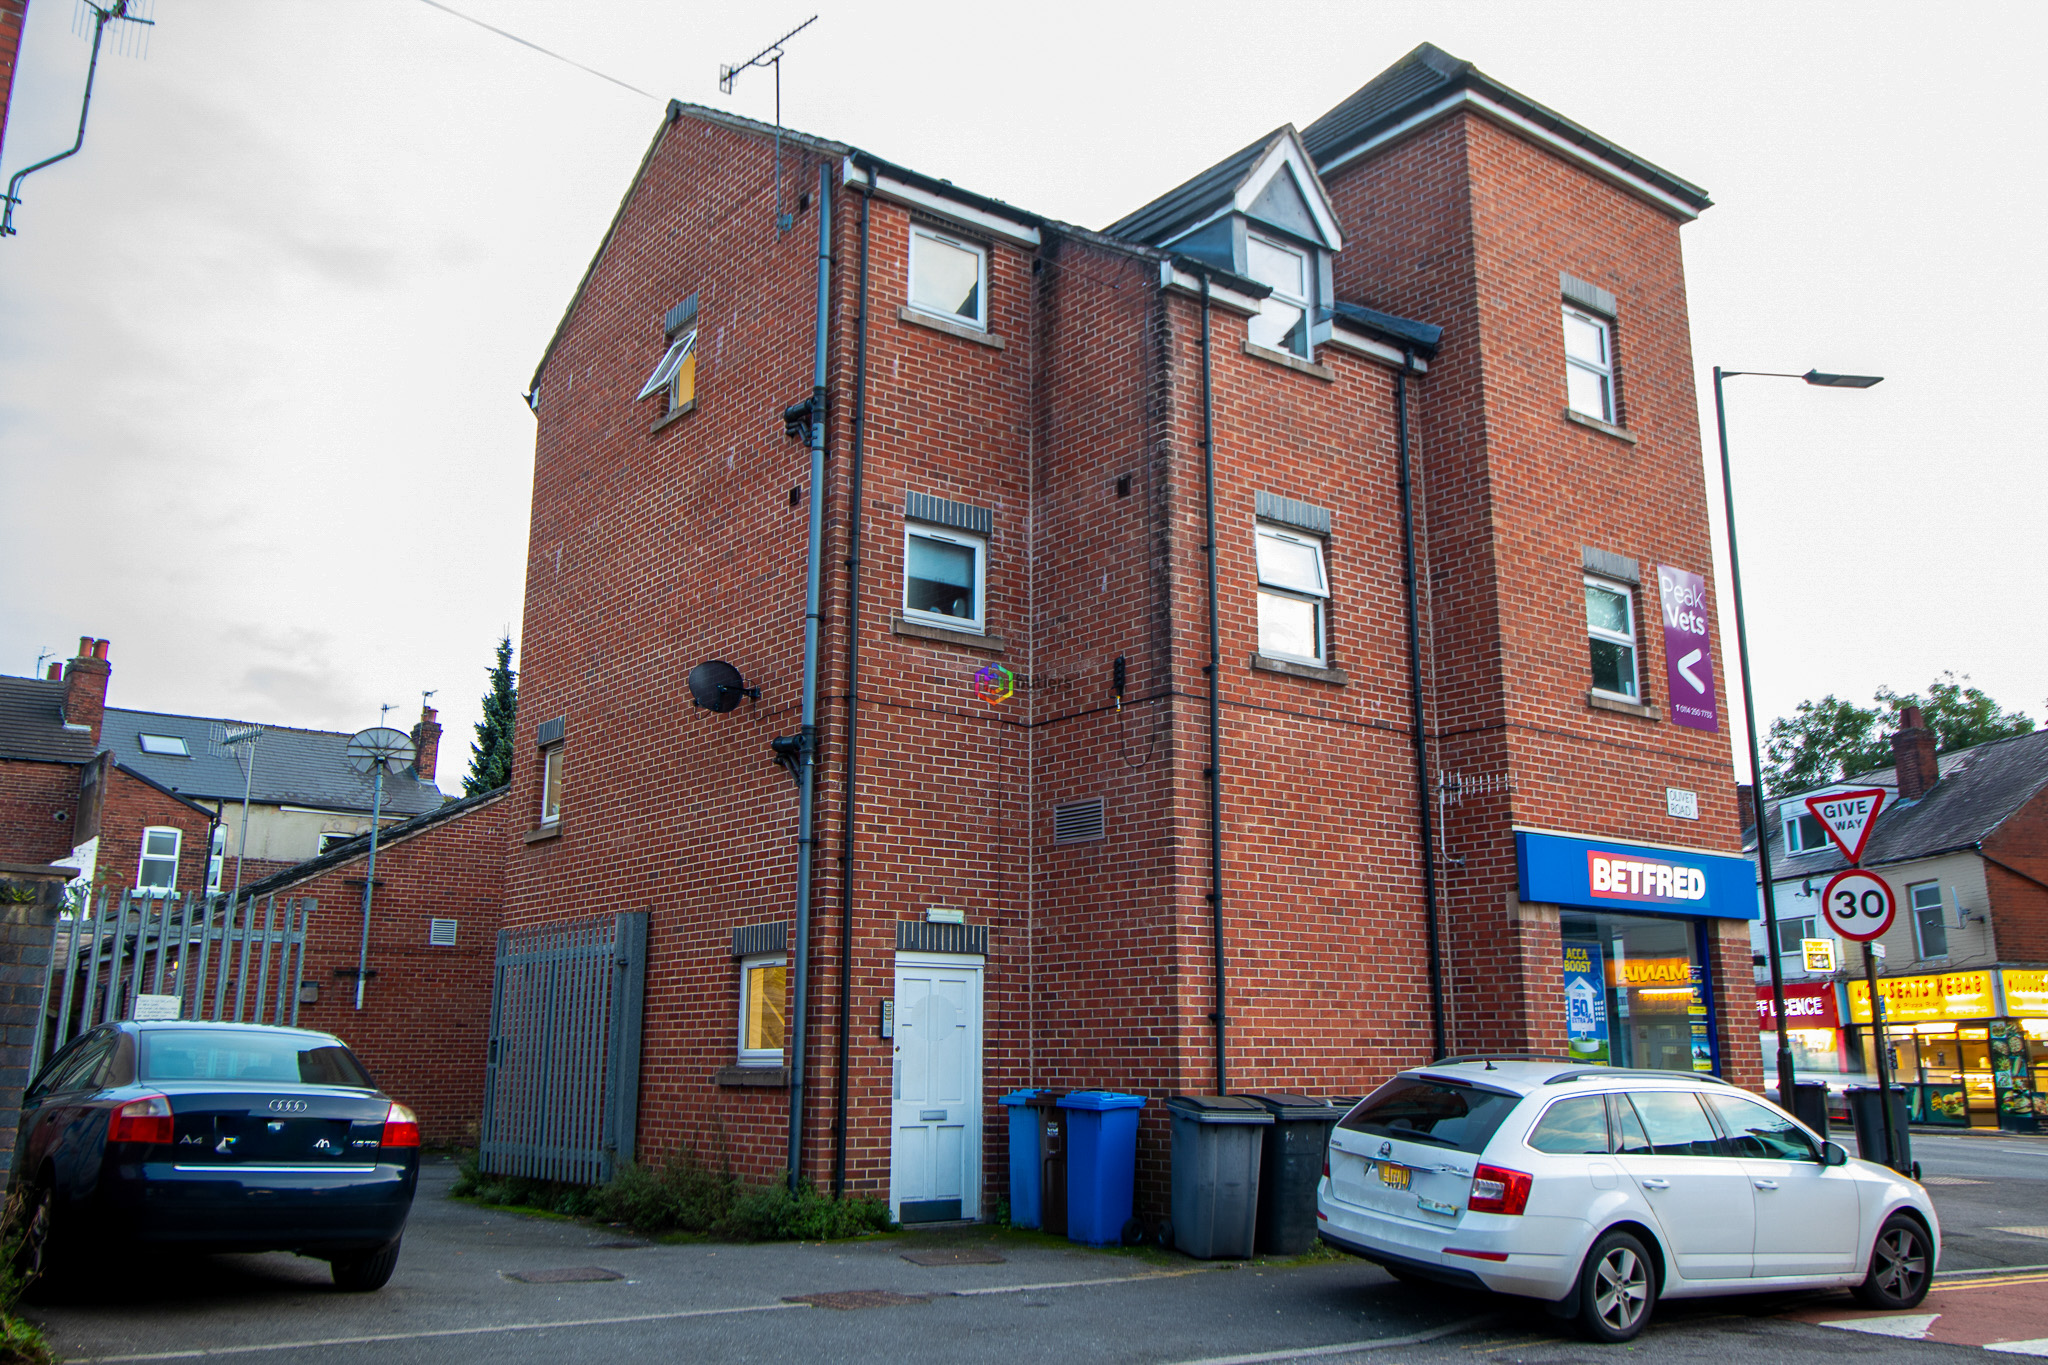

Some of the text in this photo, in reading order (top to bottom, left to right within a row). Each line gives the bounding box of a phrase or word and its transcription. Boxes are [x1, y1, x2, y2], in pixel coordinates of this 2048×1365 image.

[1661, 575, 1705, 610] Peak
[1665, 603, 1706, 636] Vets
[1668, 788, 1695, 804] OLIVET
[1670, 802, 1692, 817] ROAD
[1823, 800, 1868, 819] GIVE
[1834, 818, 1863, 831] WAY
[1592, 857, 1706, 901] BETFRED
[1834, 889, 1885, 919] 30
[1566, 947, 1588, 961] ACCA
[1563, 960, 1591, 974] BOOST
[1857, 975, 1982, 1000] WDSEATS KEBAB
[1769, 997, 1824, 1017] LCENCE
[180, 1134, 204, 1145] A4
